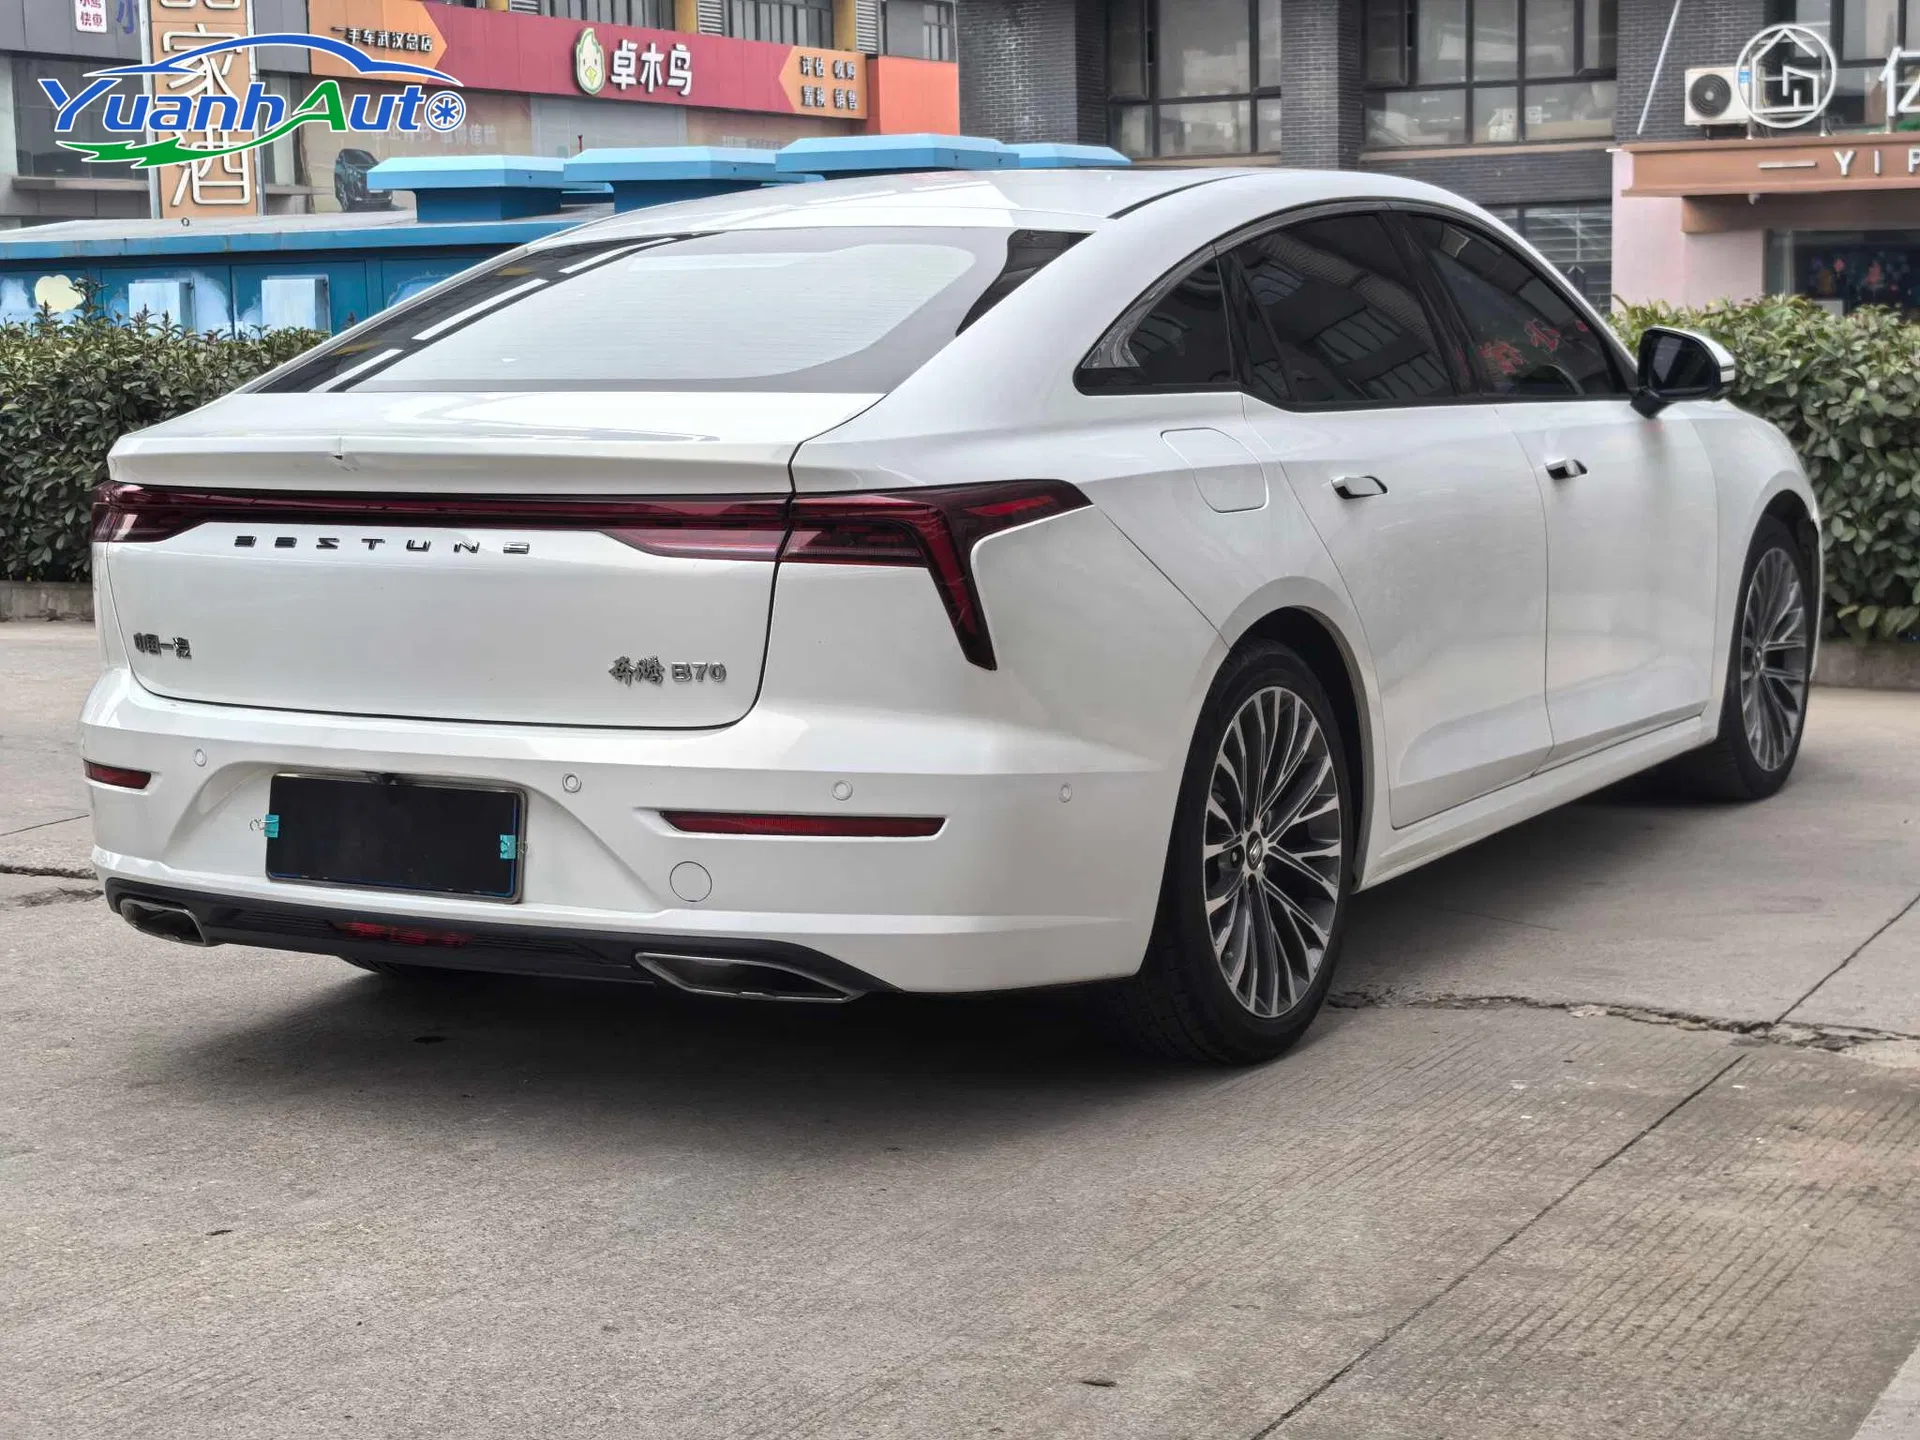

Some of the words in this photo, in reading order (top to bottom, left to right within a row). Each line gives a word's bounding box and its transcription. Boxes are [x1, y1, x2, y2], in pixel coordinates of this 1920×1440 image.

[609, 39, 693, 95] 卓木鸟
[801, 56, 824, 77] 评估
[802, 86, 825, 107] 置换
[834, 88, 857, 110] 销售
[234, 535, 530, 554] BESTUNE
[609, 656, 665, 686] 奔腾
[671, 661, 727, 683] B70
